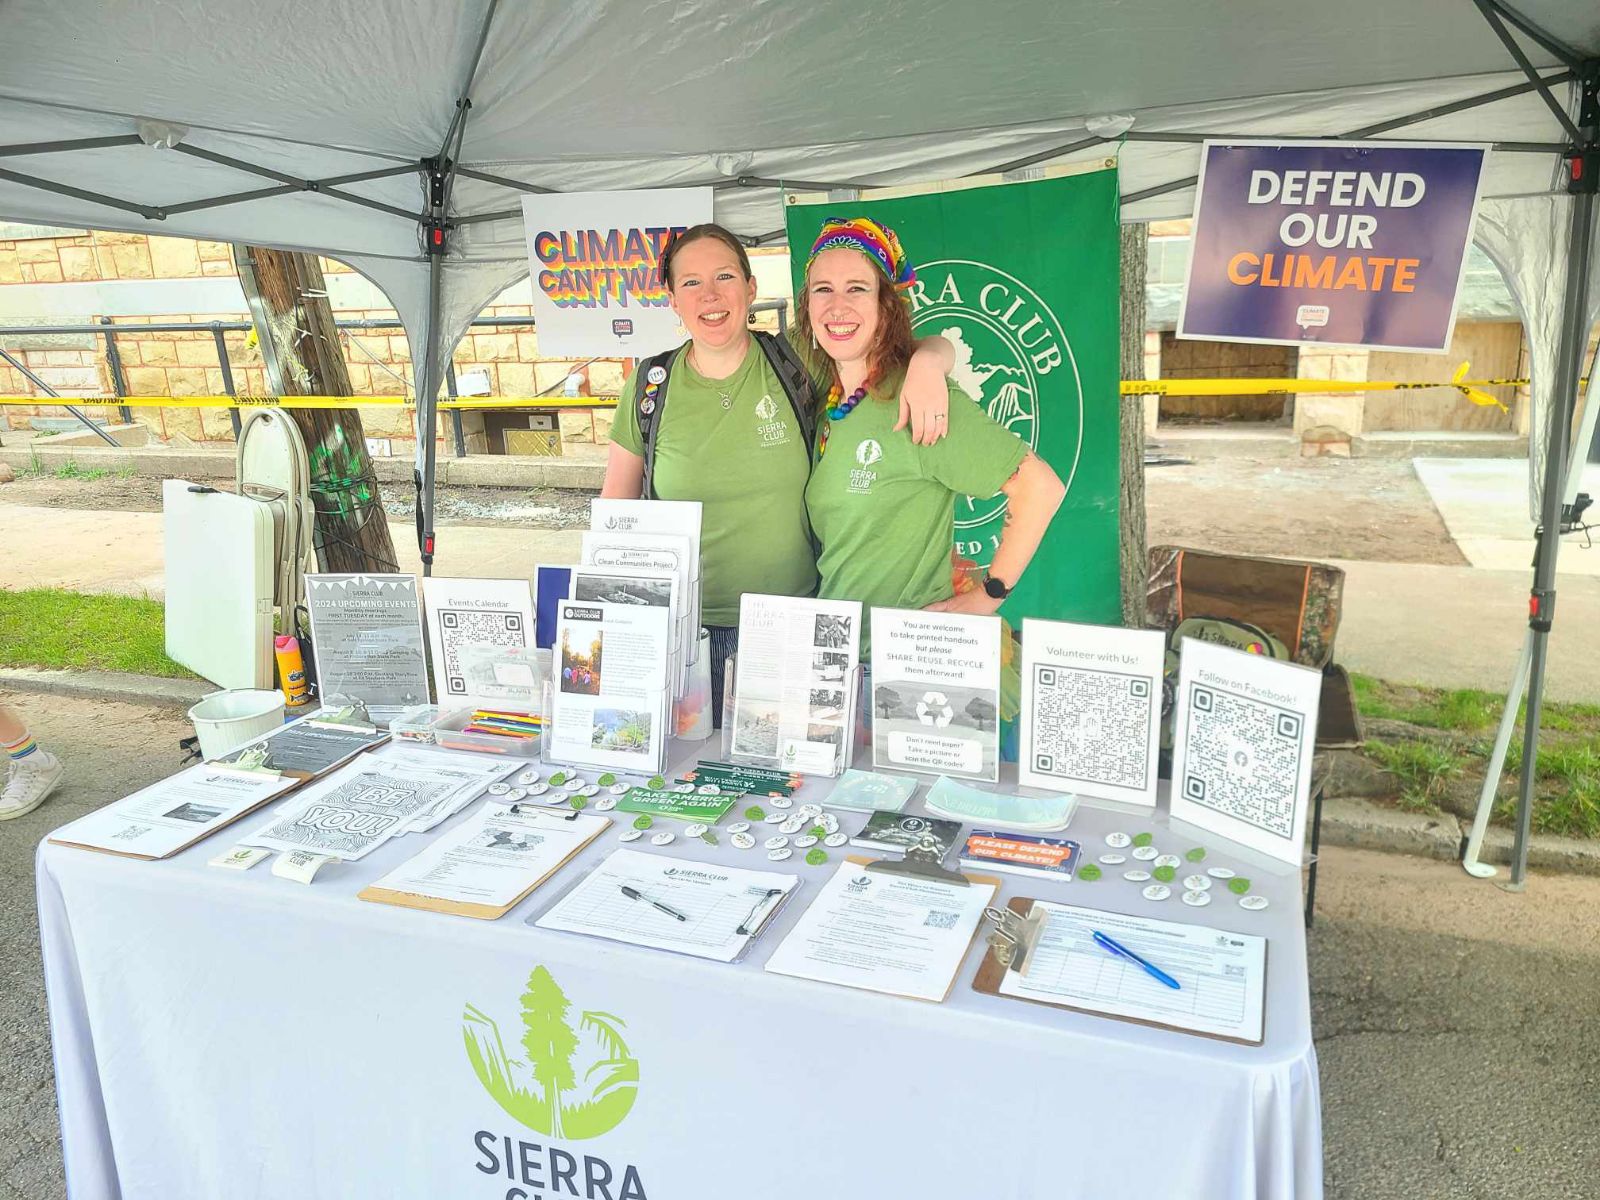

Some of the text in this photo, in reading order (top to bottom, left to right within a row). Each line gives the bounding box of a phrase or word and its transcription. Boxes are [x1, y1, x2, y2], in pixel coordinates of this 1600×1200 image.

[1247, 169, 1425, 208] DEFEND
[1279, 212, 1378, 249] OUR
[1227, 252, 1421, 293] CLIMATE
[538, 268, 617, 296] CAN'T
[979, 283, 1062, 375] CLUB
[758, 421, 787, 435] SIERRA
[763, 429, 785, 441] CLUB
[849, 469, 877, 481] SIERRA
[850, 478, 869, 489] CLUB
[616, 560, 652, 568] Communities
[315, 600, 417, 608] 2024 UPCOMING EVENTS
[448, 599, 509, 608] Events Calendar
[932, 624, 965, 633] welcome
[899, 632, 915, 640] take
[916, 633, 943, 642] printed
[944, 635, 978, 645] handouts
[915, 644, 952, 654] but please
[1046, 646, 1139, 665] Volunteer with Us!
[904, 666, 923, 674] them
[947, 659, 984, 669] RECYCLE
[1199, 669, 1297, 705] Follow on Facebook!
[906, 735, 923, 743] Don't
[908, 745, 923, 753] Take
[929, 748, 952, 757] picture
[357, 785, 413, 807] BE
[632, 790, 730, 803] MAKE AMERICA
[632, 796, 676, 805] GREEN
[297, 805, 399, 837] YOU!
[973, 839, 1064, 856] PLEASE DEFEND
[289, 857, 307, 867] CLUB
[974, 848, 1056, 864] OUR CLIMATE!
[680, 869, 707, 878] SIERRA
[474, 1130, 648, 1200] SIERRA
